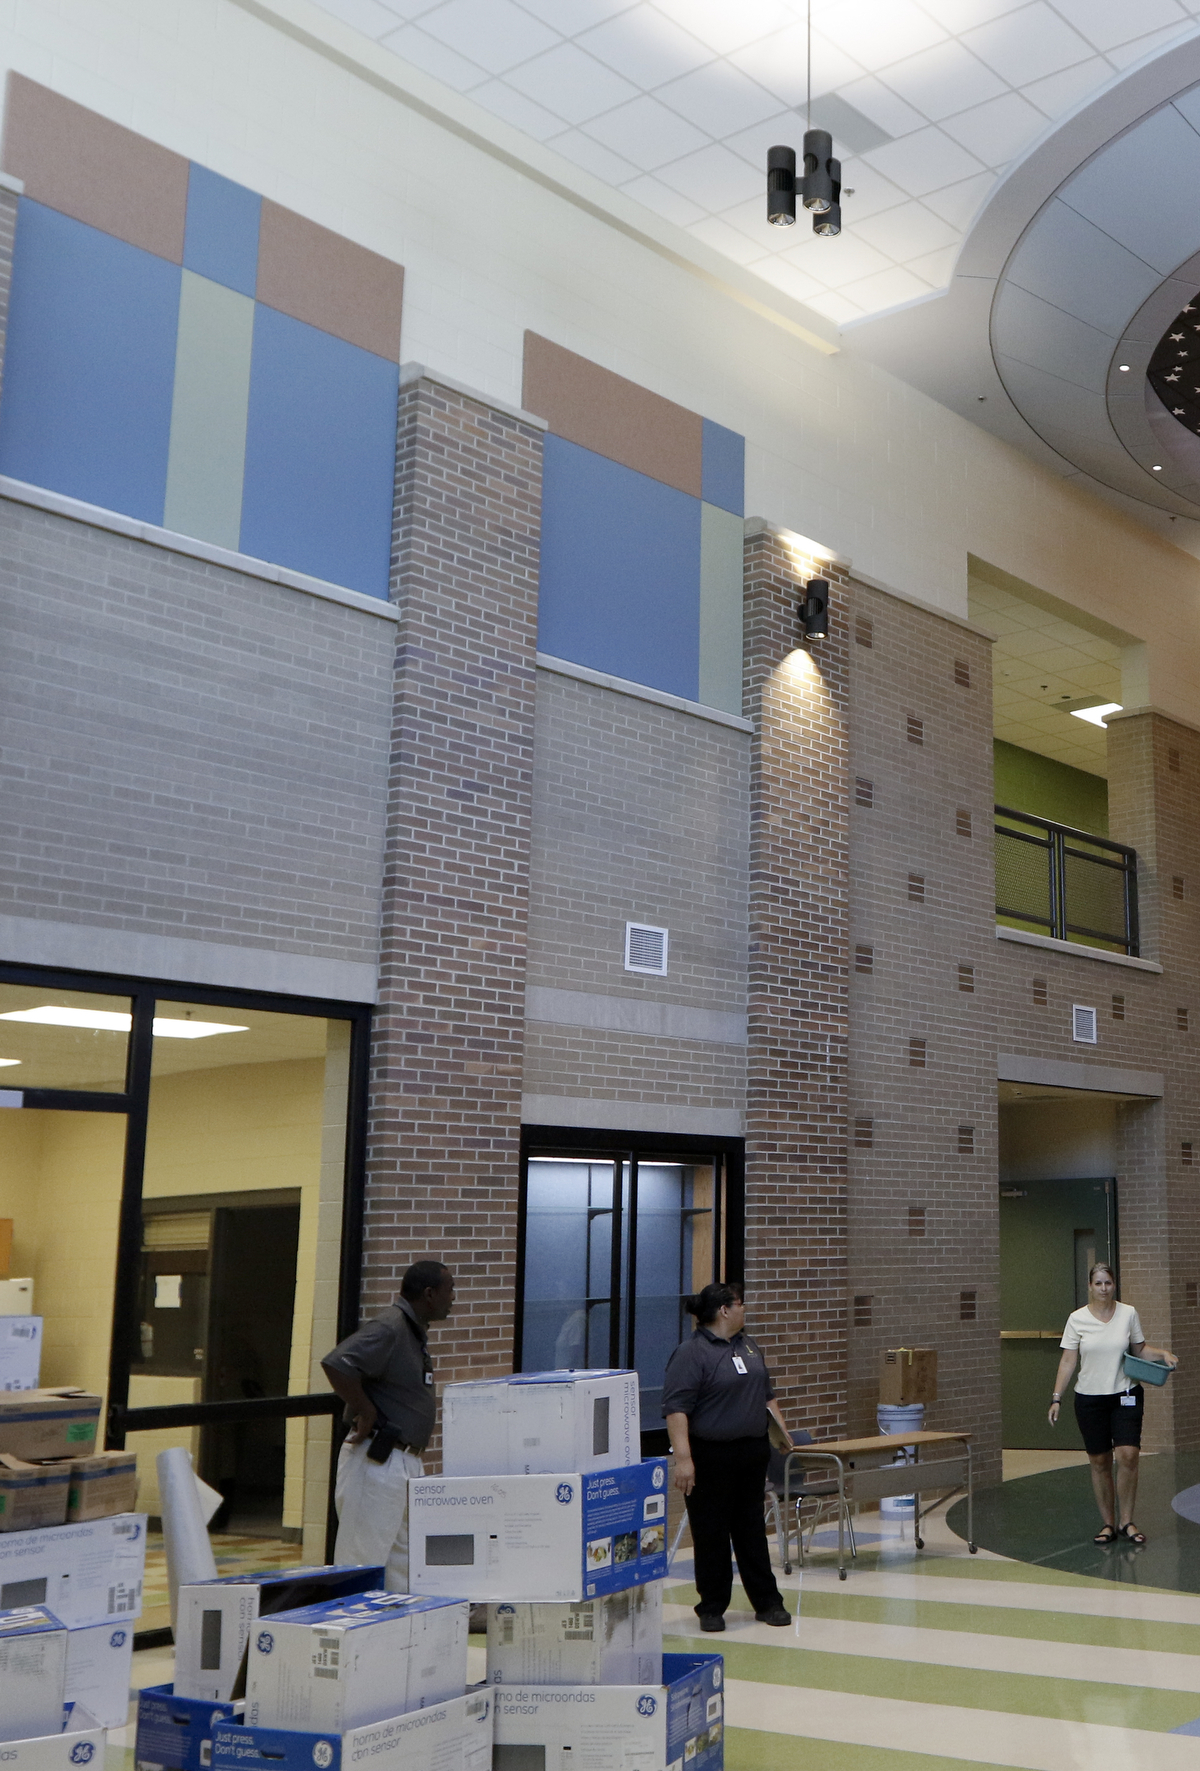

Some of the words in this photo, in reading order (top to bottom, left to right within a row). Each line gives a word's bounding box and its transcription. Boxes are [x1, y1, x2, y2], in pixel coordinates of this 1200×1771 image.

[414, 1483, 446, 1495] sensor
[586, 1478, 601, 1490] Just
[414, 1496, 468, 1507] microwave
[470, 1495, 494, 1506] oven
[586, 1489, 602, 1501] Don't
[602, 1487, 620, 1500] guess.
[0, 1538, 23, 1549] orno
[39, 1527, 94, 1543] microondas
[13, 1545, 46, 1557] sensor
[495, 1692, 513, 1702] rno
[514, 1690, 529, 1702] de
[531, 1690, 596, 1703] microondas
[503, 1705, 539, 1715] sensor
[352, 1731, 381, 1747] horno
[382, 1724, 395, 1739] de
[395, 1709, 448, 1732] microondas
[214, 1731, 231, 1744] Just
[231, 1734, 255, 1746] press.
[70, 1741, 96, 1766] GE
[214, 1744, 235, 1755] Don't
[236, 1747, 261, 1760] guess.
[351, 1747, 369, 1762] con
[370, 1737, 402, 1756] sensor
